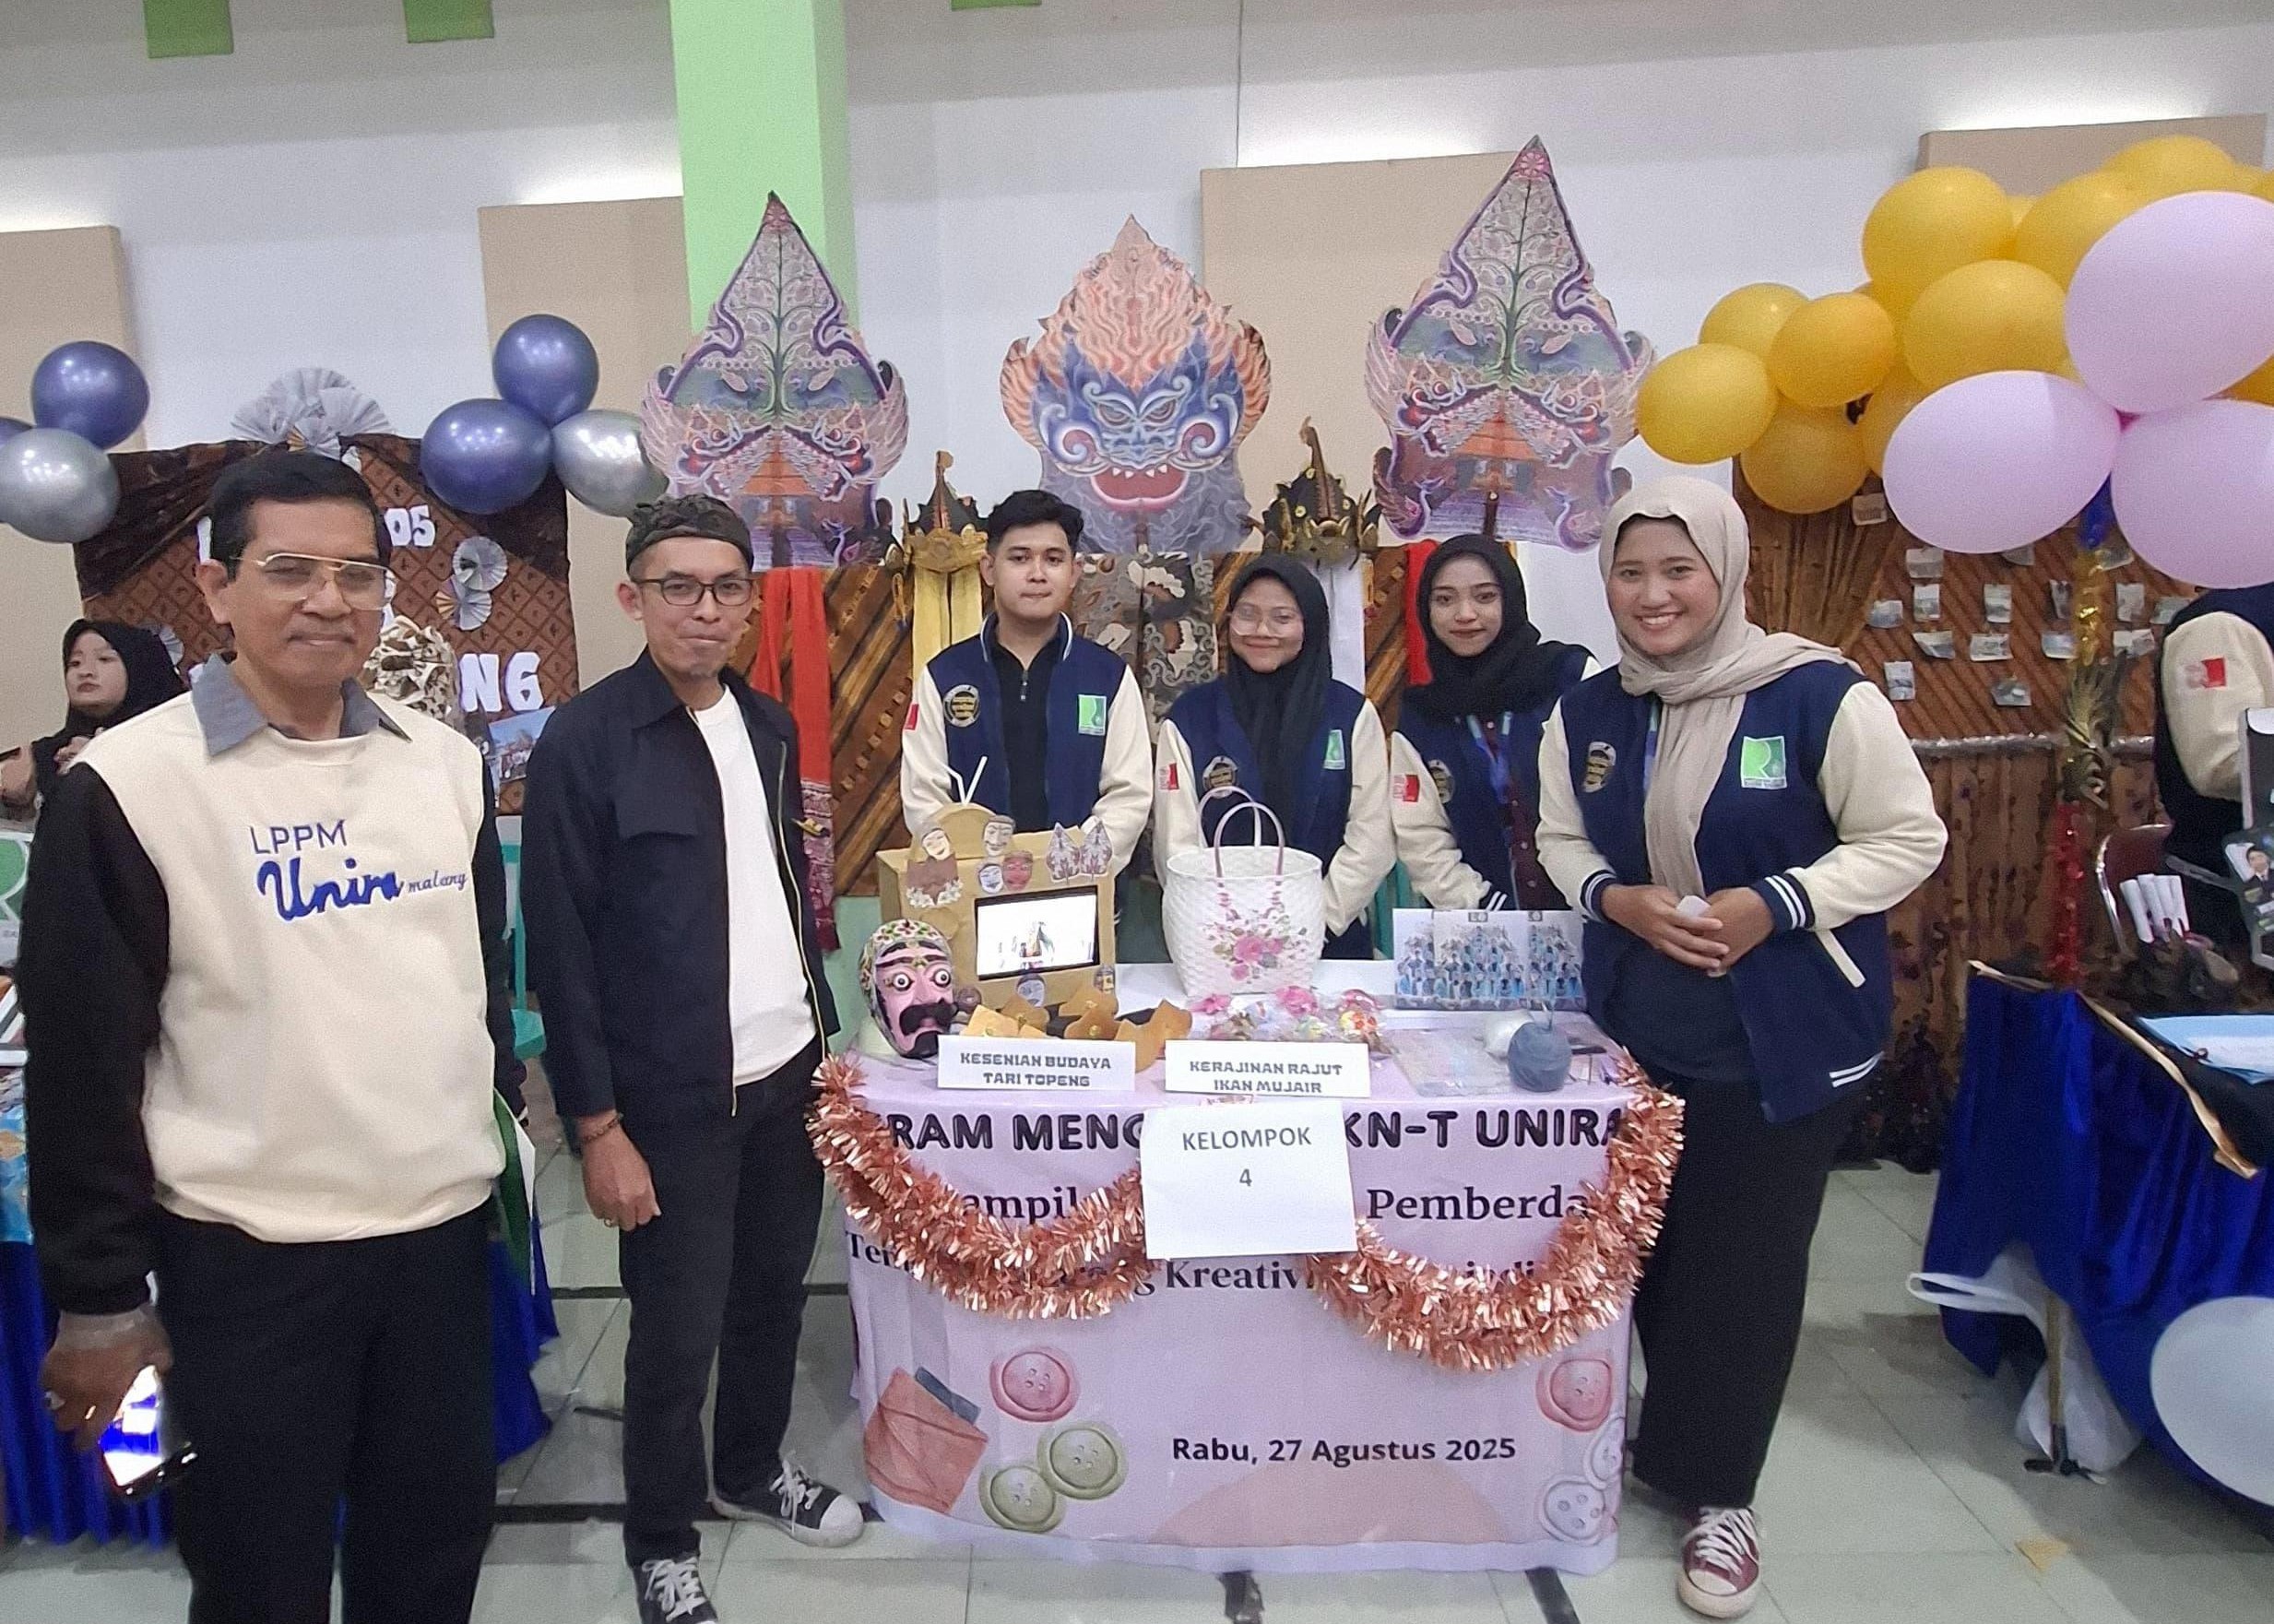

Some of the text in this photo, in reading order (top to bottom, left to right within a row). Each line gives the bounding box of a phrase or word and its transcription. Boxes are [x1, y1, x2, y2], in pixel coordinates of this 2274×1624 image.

[249, 819, 348, 854] LPPM
[960, 1052, 1111, 1069] KESENIAN BUDAYA
[1190, 1061, 1343, 1075] KERAJINAN RAJUT
[983, 1072, 1091, 1087] TARI TOPENG
[1214, 1079, 1322, 1094] IKAN MUJAIR
[886, 1112, 993, 1150] RAM
[1182, 1126, 1313, 1151] KELOMPOK
[1238, 1168, 1253, 1187] 4
[1172, 1438, 1516, 1467] Rabu, 27 Agustus 2025
